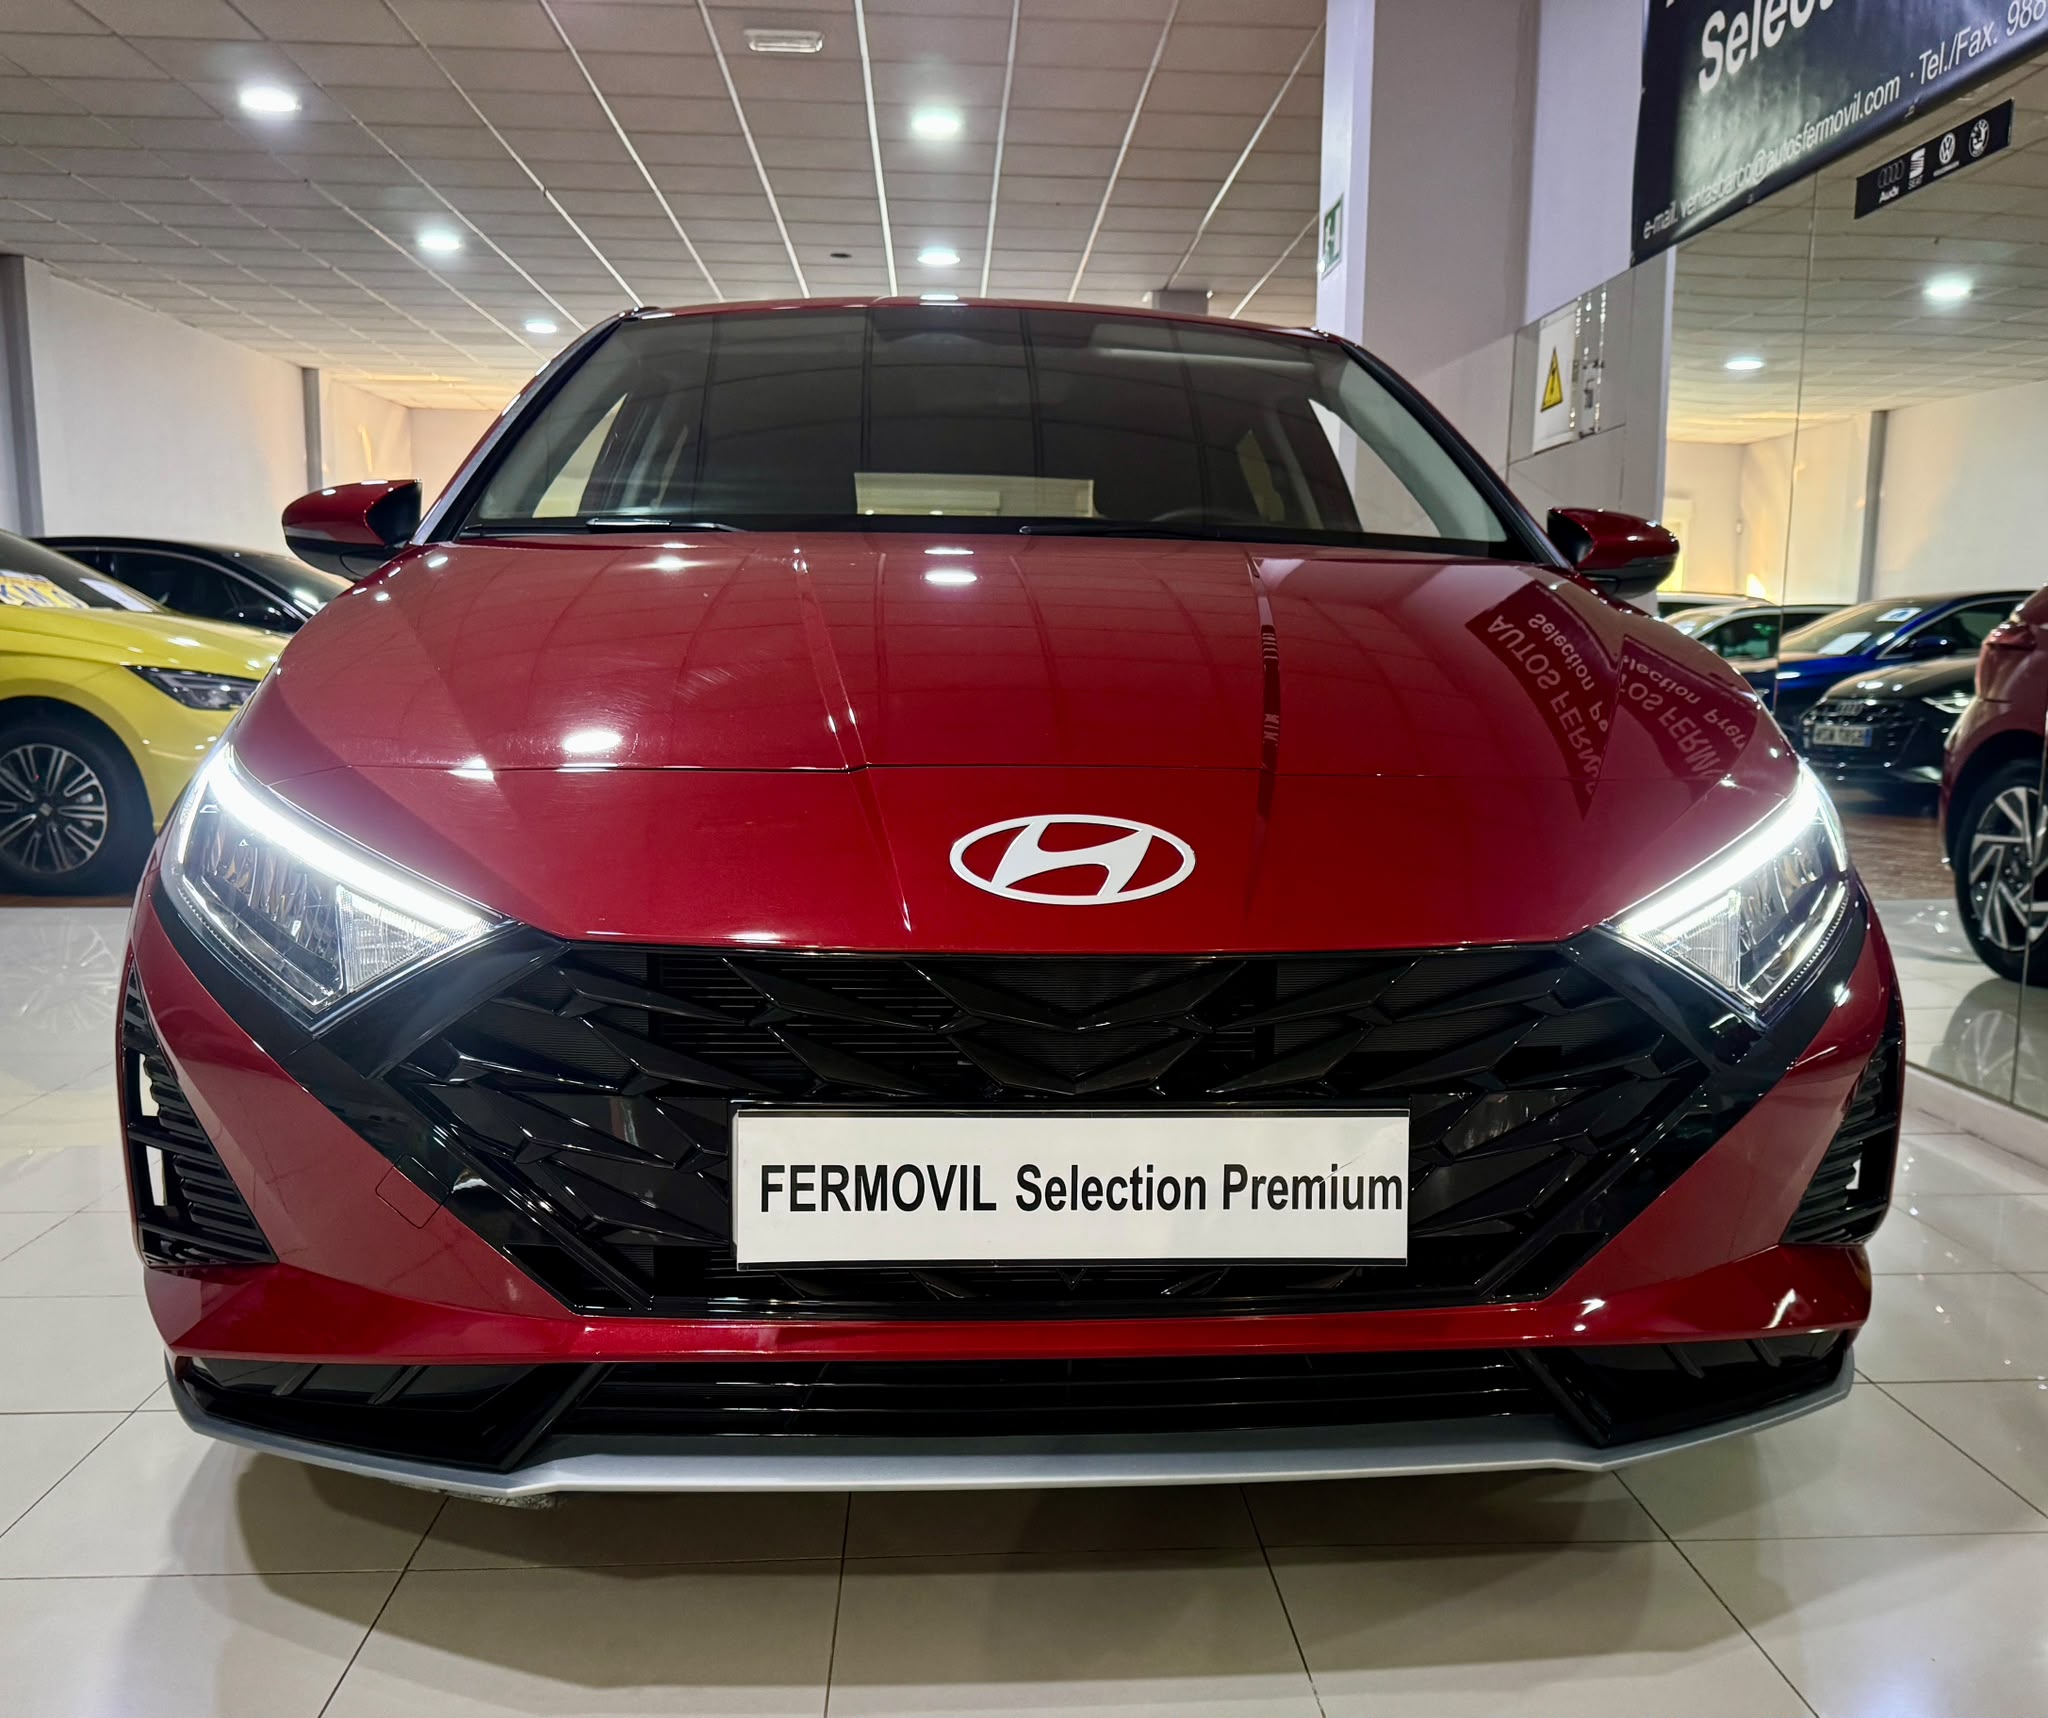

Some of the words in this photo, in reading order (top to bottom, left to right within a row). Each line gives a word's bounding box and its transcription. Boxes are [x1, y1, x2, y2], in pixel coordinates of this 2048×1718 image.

[1699, 0, 1834, 94] Selec
[1919, 21, 1997, 84] Tel./Fax.
[761, 1163, 997, 1213] FERMOVIL
[1015, 1163, 1206, 1212] Selection
[1223, 1163, 1402, 1211] Premium
